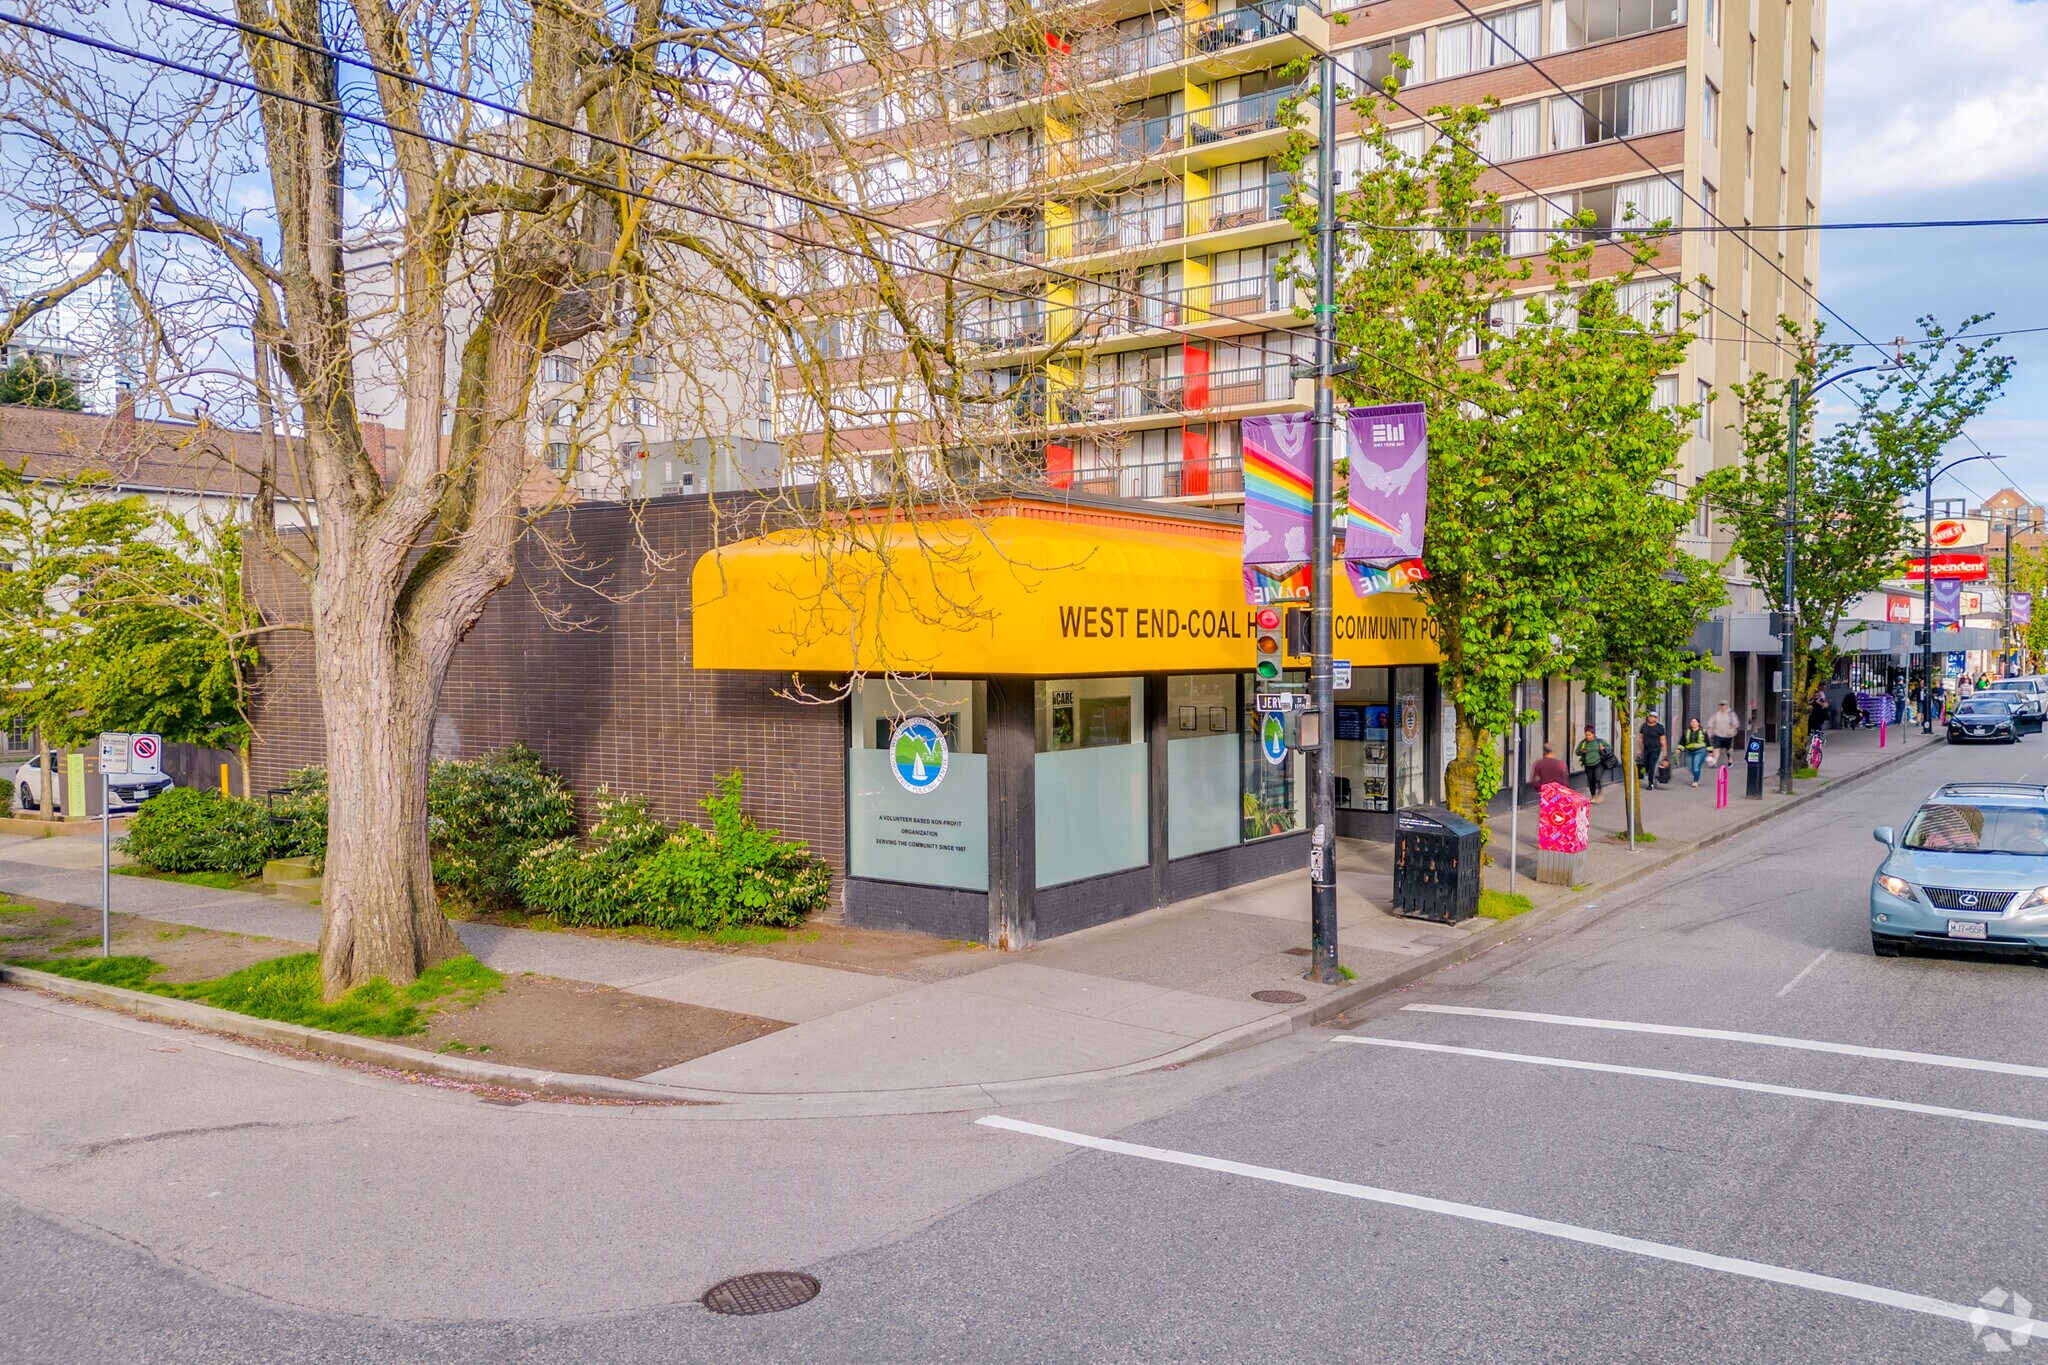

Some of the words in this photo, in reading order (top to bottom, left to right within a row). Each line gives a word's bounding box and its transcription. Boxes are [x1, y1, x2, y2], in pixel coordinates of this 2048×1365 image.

[1931, 528, 1954, 541] DAVIE
[1059, 606, 1129, 638] WEST
[1136, 608, 1241, 639] END-COAL
[1335, 615, 1418, 640] COMMUNITY
[1056, 692, 1073, 705] CARE
[1261, 696, 1281, 709] JERV
[883, 815, 912, 823] VOLUNTEER
[931, 818, 962, 827] NON-PROFIT
[901, 828, 938, 837] ORGANIZATION
[876, 838, 897, 846] SERVING
[908, 841, 938, 850] COMMUNITY
